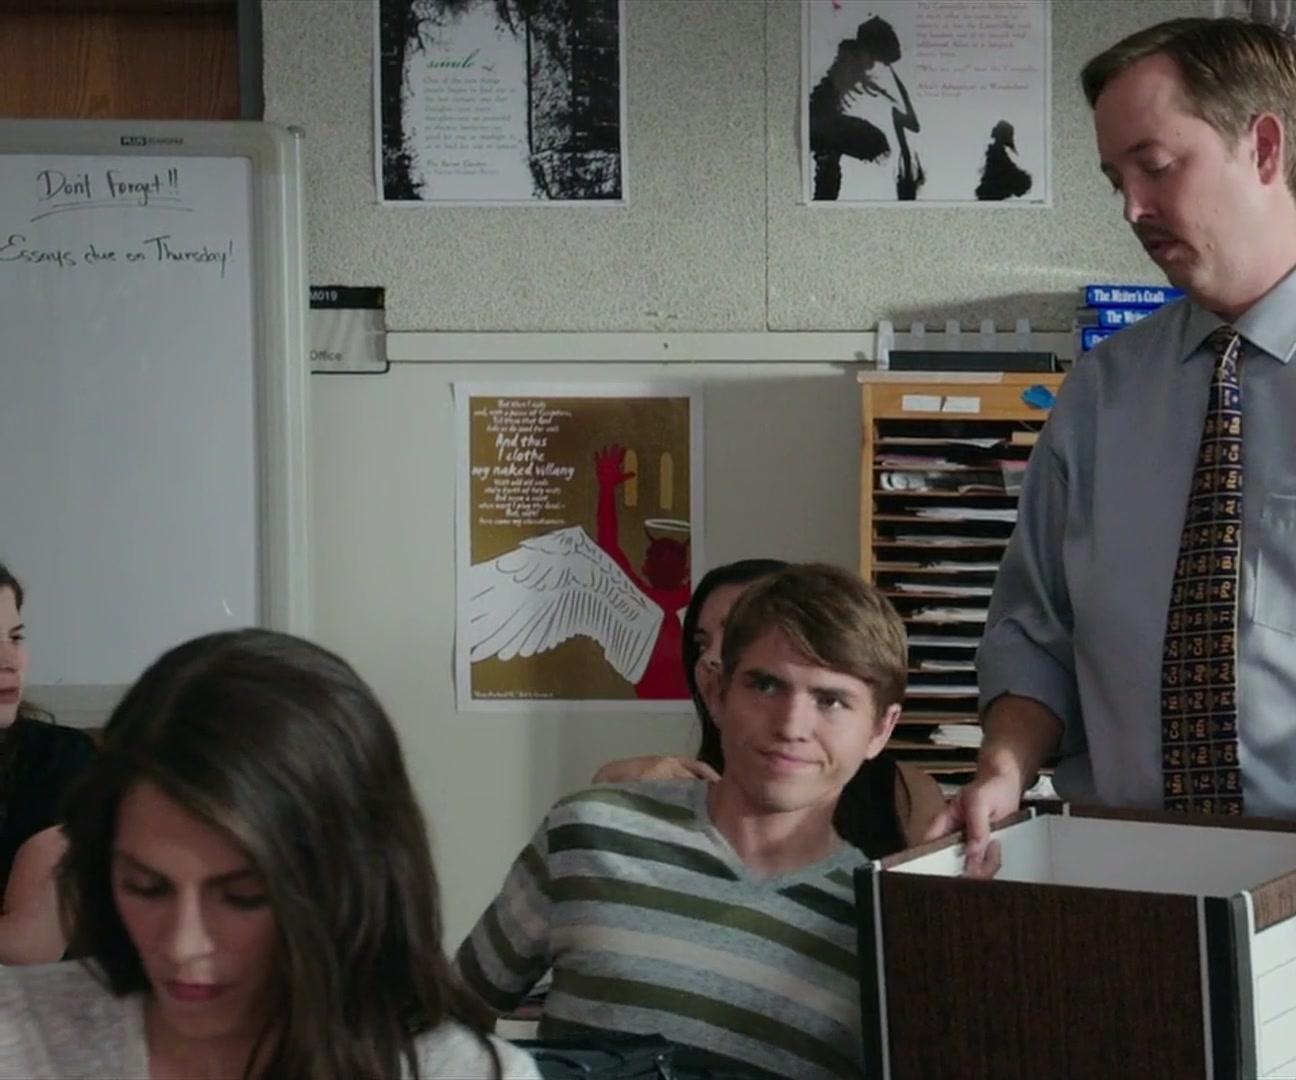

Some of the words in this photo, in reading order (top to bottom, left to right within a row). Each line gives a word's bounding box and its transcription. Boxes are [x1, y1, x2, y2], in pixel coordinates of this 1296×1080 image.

[427, 48, 480, 69] simile
[0, 233, 77, 268] Essays
[84, 244, 117, 264] due
[126, 251, 146, 263] on
[143, 234, 234, 279] Thursday!
[1094, 288, 1110, 303] The
[1144, 288, 1165, 303] Craft
[1106, 310, 1122, 324] The
[495, 433, 519, 448] And
[520, 433, 548, 448] thus
[498, 447, 505, 462] I
[506, 447, 545, 462] clothe
[472, 465, 491, 481] my
[492, 462, 535, 477] naked
[535, 462, 575, 481] villany
